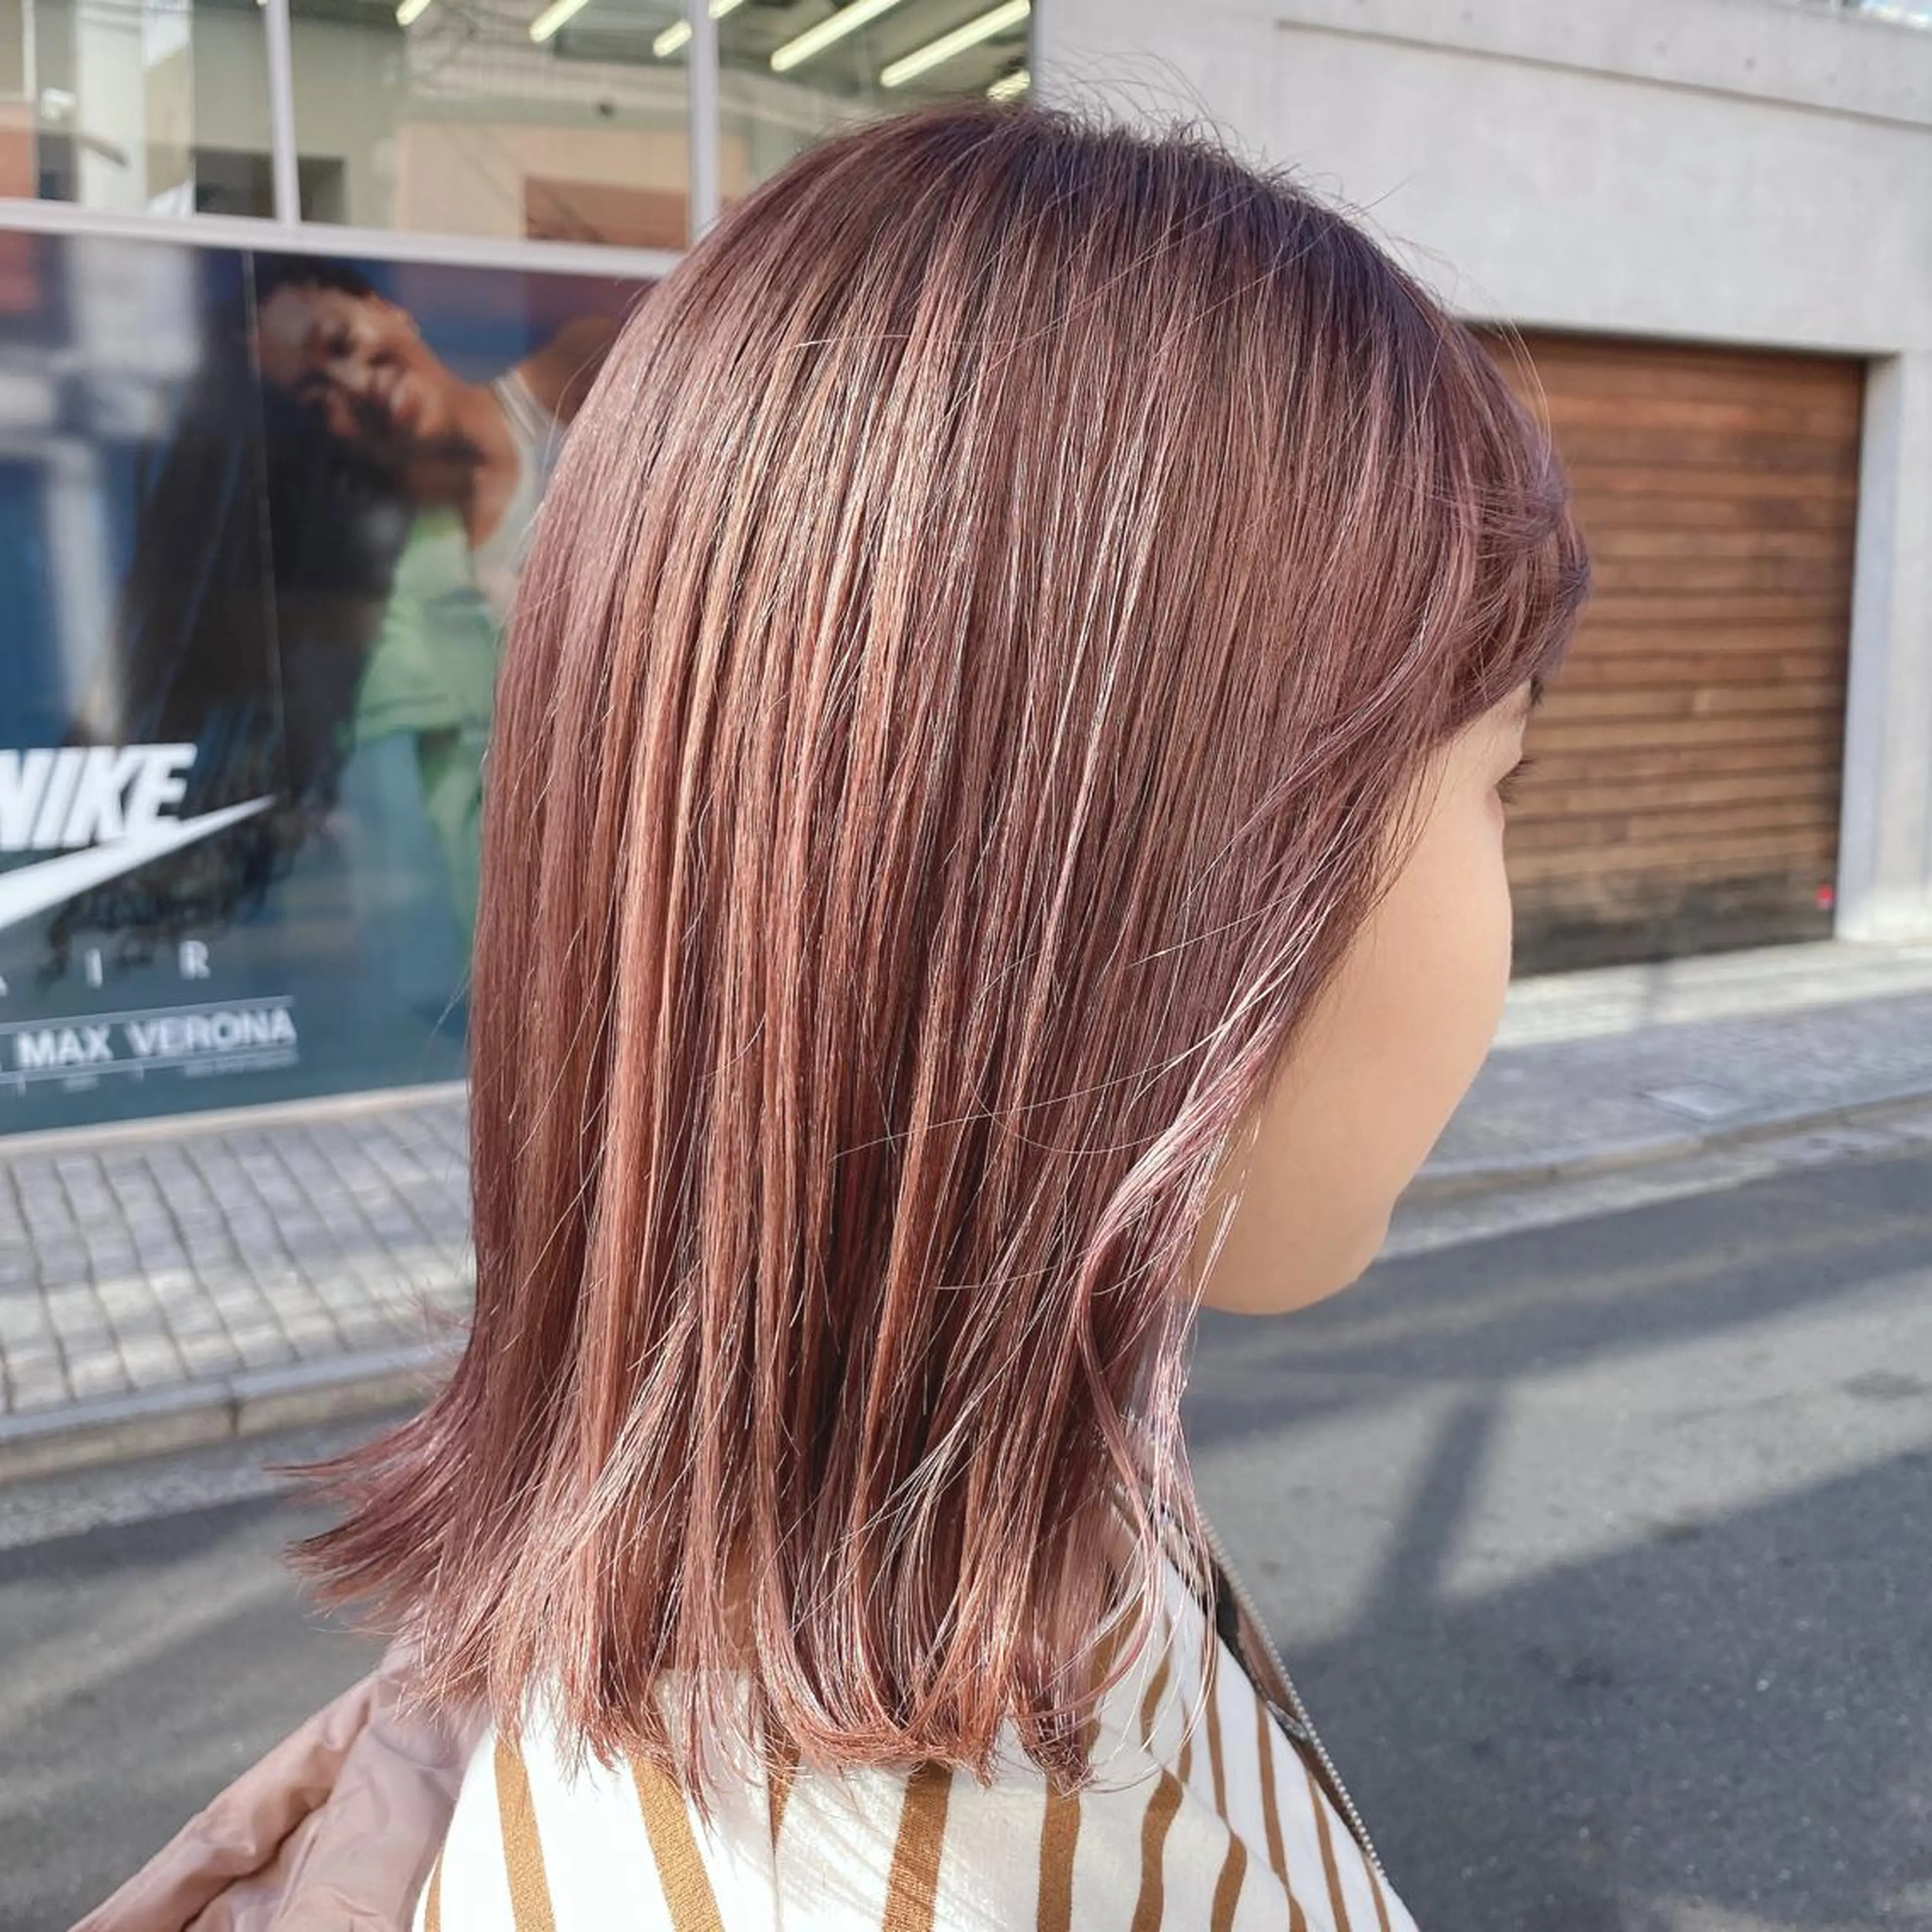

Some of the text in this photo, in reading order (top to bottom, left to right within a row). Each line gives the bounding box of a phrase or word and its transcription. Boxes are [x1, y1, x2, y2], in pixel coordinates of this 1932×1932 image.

[0, 744, 197, 851] NIKE
[15, 1008, 296, 1068] MAX VERONA
